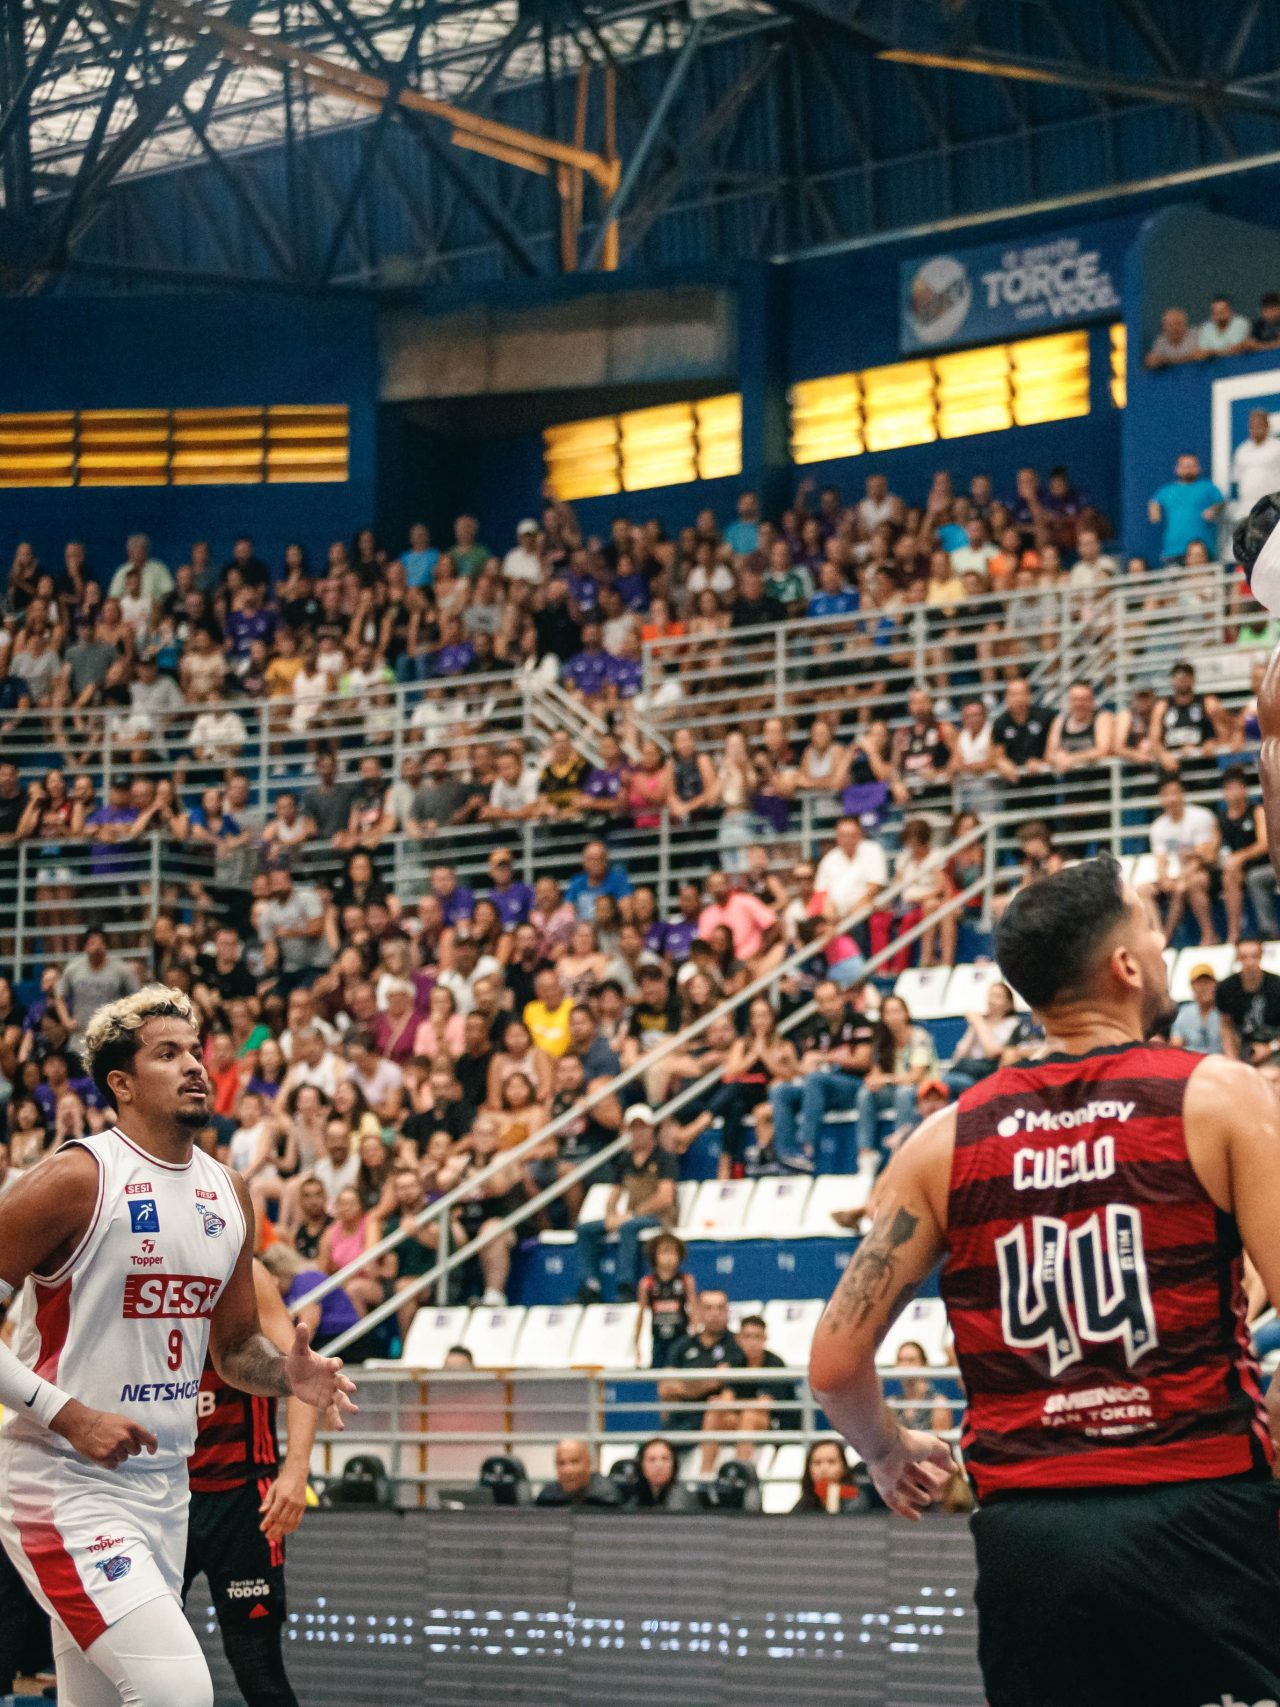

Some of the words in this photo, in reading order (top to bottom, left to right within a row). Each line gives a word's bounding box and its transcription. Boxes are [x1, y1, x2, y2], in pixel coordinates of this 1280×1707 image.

[982, 251, 1100, 308] TORCE
[128, 1183, 150, 1193] SESI
[130, 1255, 164, 1267] Topper
[136, 1279, 220, 1315] SESI
[994, 1203, 1159, 1378] 44
[167, 1328, 184, 1371] 9
[1088, 1405, 1152, 1421] TOKEN
[87, 1535, 126, 1554] Topper
[226, 1583, 270, 1600] TODOS
